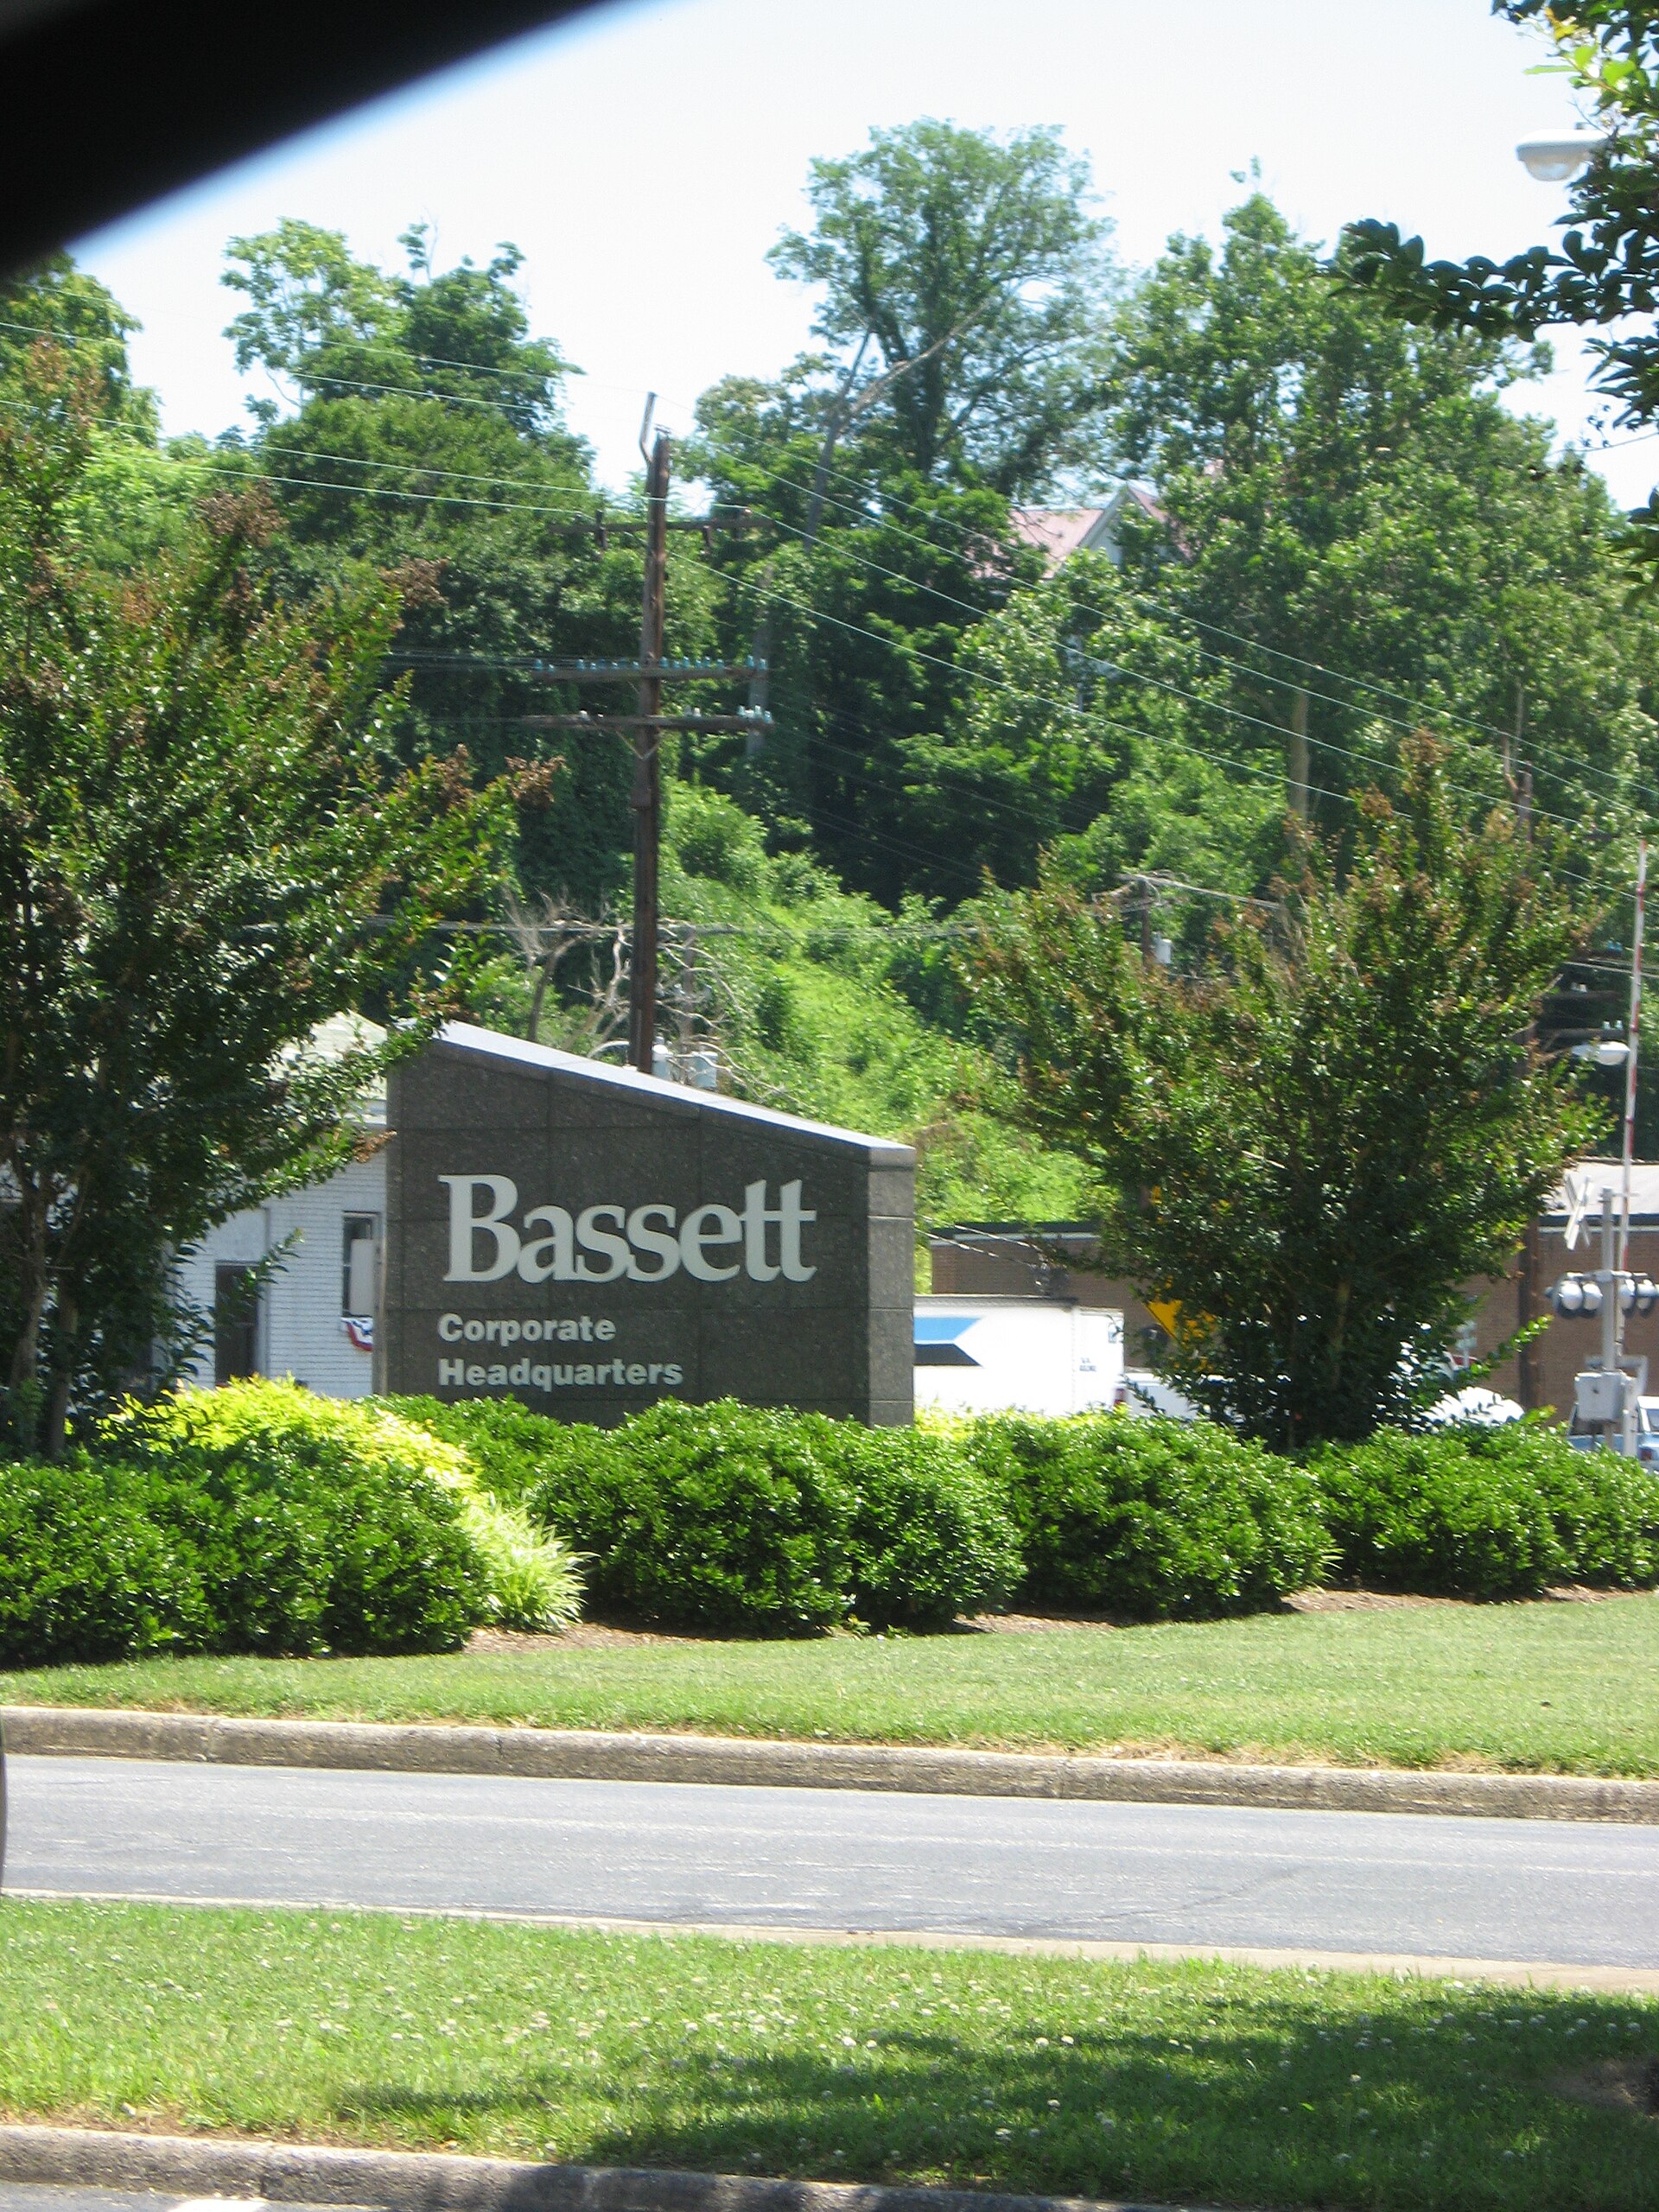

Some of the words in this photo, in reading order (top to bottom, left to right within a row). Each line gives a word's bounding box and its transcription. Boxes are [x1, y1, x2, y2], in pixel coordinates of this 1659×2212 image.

[438, 1174, 817, 1283] Bassett
[438, 1313, 615, 1346] Corporate
[438, 1357, 683, 1392] Headquarters
